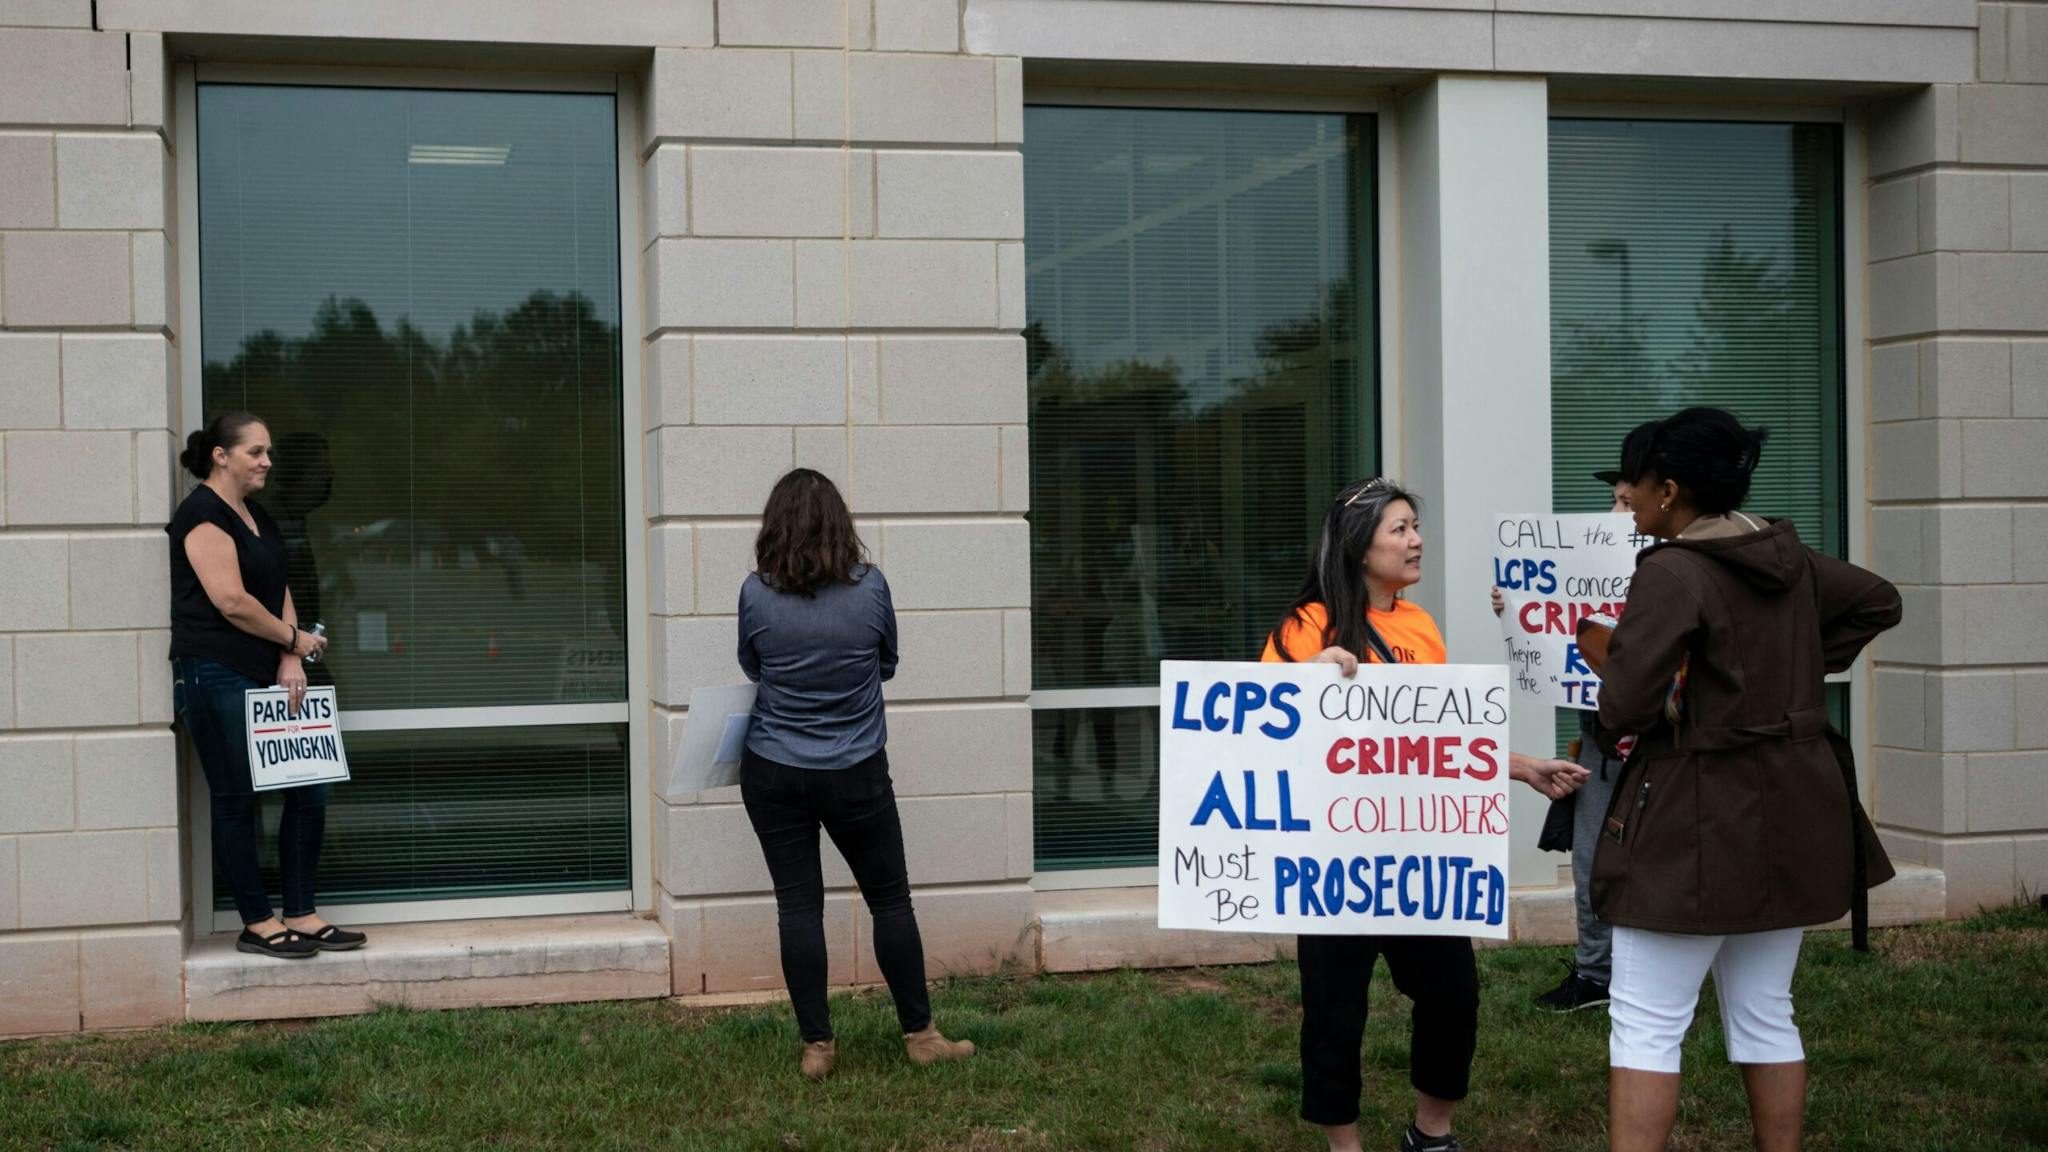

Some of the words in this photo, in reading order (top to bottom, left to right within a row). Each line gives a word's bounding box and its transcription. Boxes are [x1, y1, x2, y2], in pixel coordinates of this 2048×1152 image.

[1498, 520, 1574, 549] CALL
[1583, 523, 1617, 546] the
[1494, 557, 1557, 594] LCPS
[1519, 601, 1626, 635] CRI
[1516, 669, 1541, 695] the
[1172, 681, 1302, 740] LCPS
[1319, 684, 1507, 725] CONCEALS
[256, 735, 339, 768] YOUNGKIN
[1326, 735, 1498, 781] CRIMES
[1190, 770, 1311, 832] ALL
[1327, 793, 1508, 835] COLLUDERS
[1205, 888, 1260, 924] Be
[1274, 855, 1505, 926] PROSECUTED
